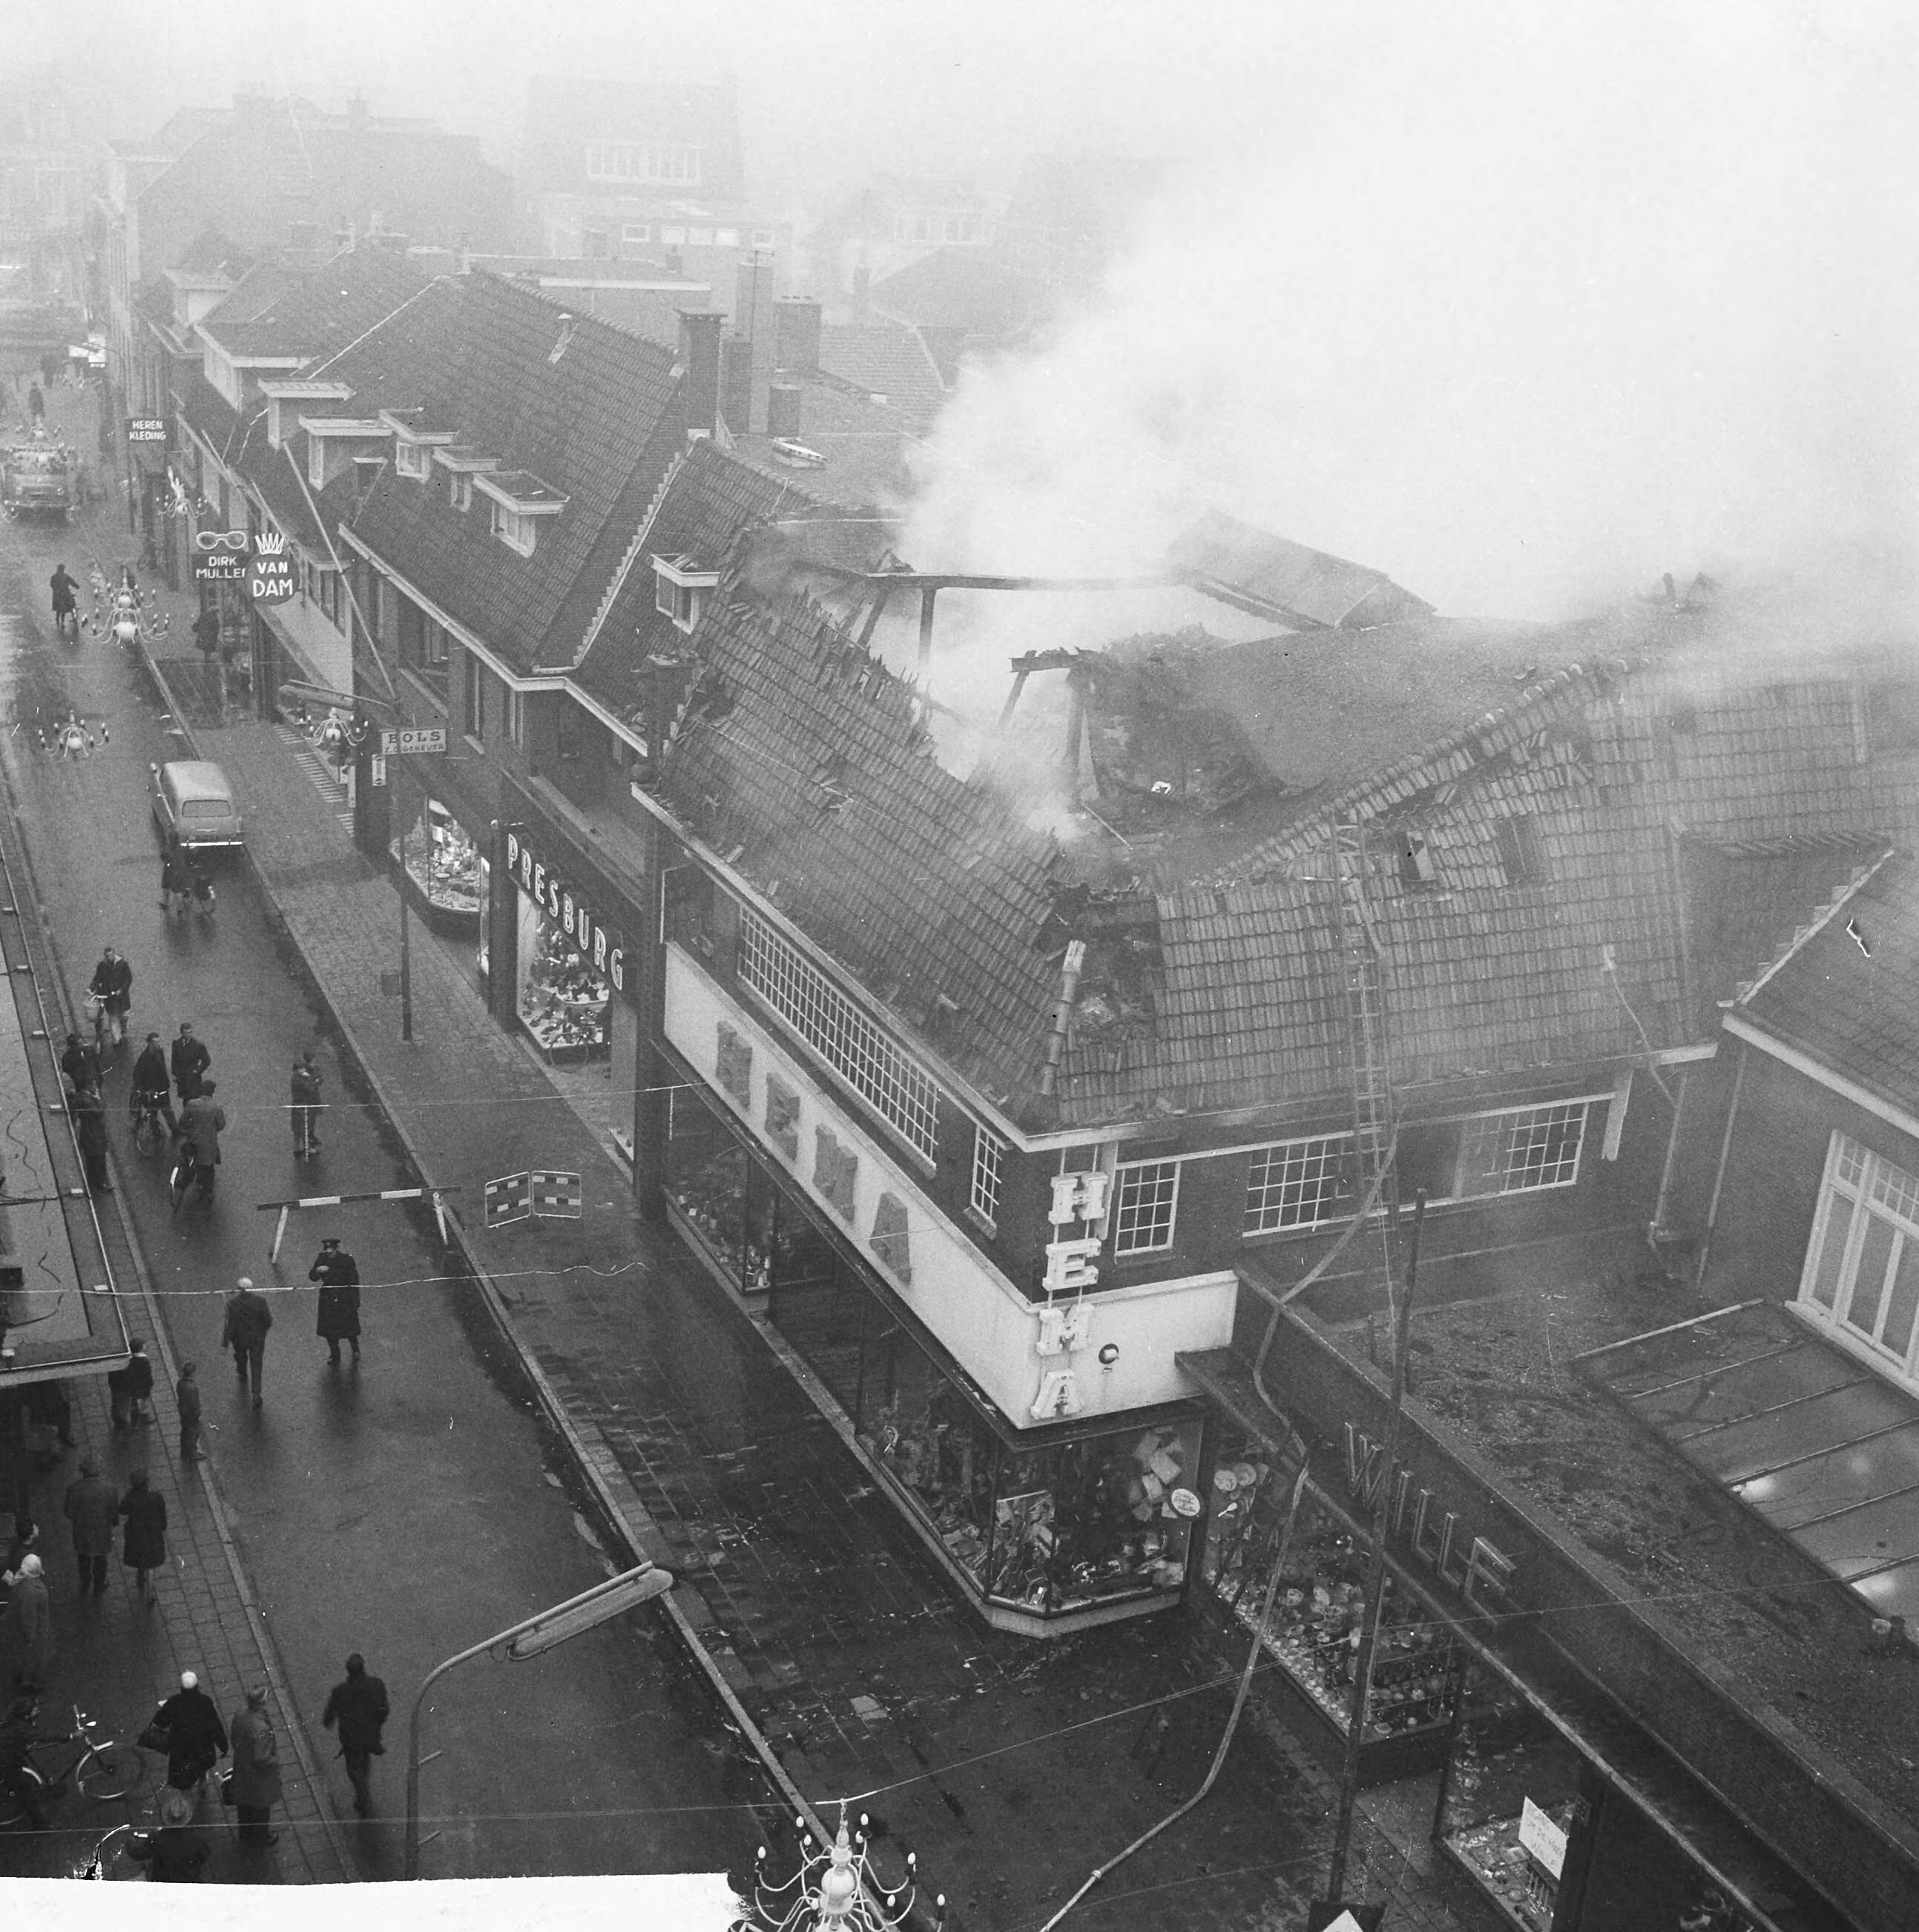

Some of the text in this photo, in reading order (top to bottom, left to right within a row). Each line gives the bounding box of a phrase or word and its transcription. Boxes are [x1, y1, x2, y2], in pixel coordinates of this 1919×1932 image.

[132, 420, 163, 430] HEREN
[129, 430, 167, 441] KLEDING
[208, 556, 237, 567] DIRK
[256, 561, 289, 574] VAN
[253, 578, 294, 597] DAM
[507, 833, 624, 990] PRESBURG
[1030, 1171, 1108, 1420] HEMA
[1343, 1422, 1518, 1626] WILLE
